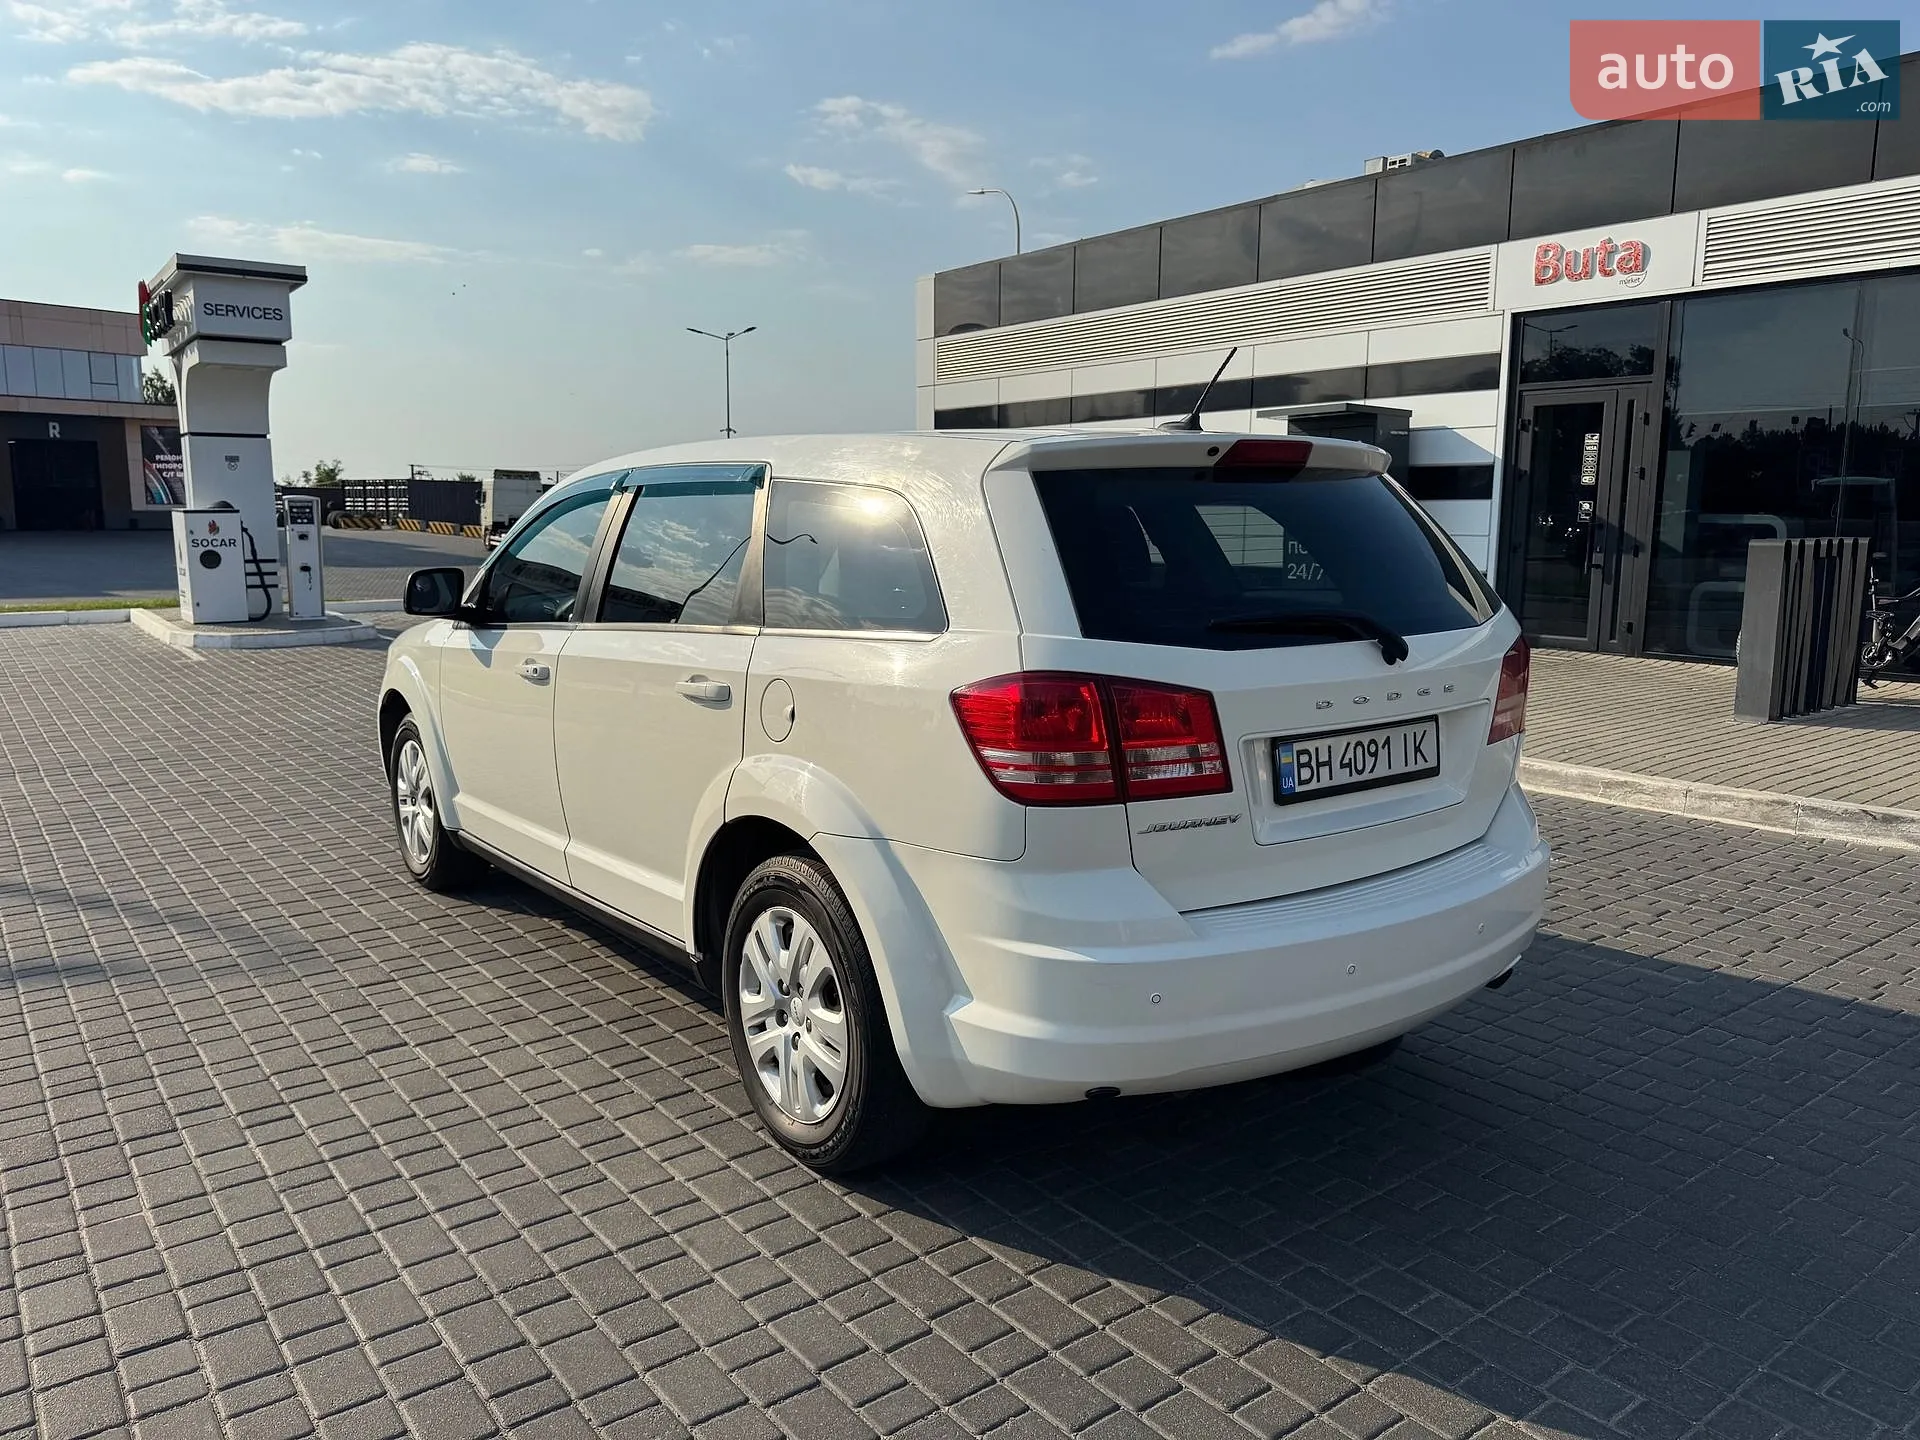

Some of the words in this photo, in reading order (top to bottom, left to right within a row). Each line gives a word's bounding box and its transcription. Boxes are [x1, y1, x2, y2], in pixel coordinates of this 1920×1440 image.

[1534, 237, 1645, 286] Buta
[1618, 277, 1641, 286] market
[203, 302, 283, 321] SERVICES
[48, 421, 61, 438] R
[152, 462, 183, 470] ТИПОРО
[155, 454, 184, 462] РЕМОН
[191, 538, 237, 548] SOCAR
[1287, 562, 1324, 581] 24/7
[1316, 684, 1455, 710] DODGE
[1297, 745, 1333, 786] BH
[1340, 736, 1392, 778] 4091
[1403, 730, 1429, 768] IK
[1282, 777, 1295, 789] UA
[1136, 813, 1242, 835] JOURNEY
